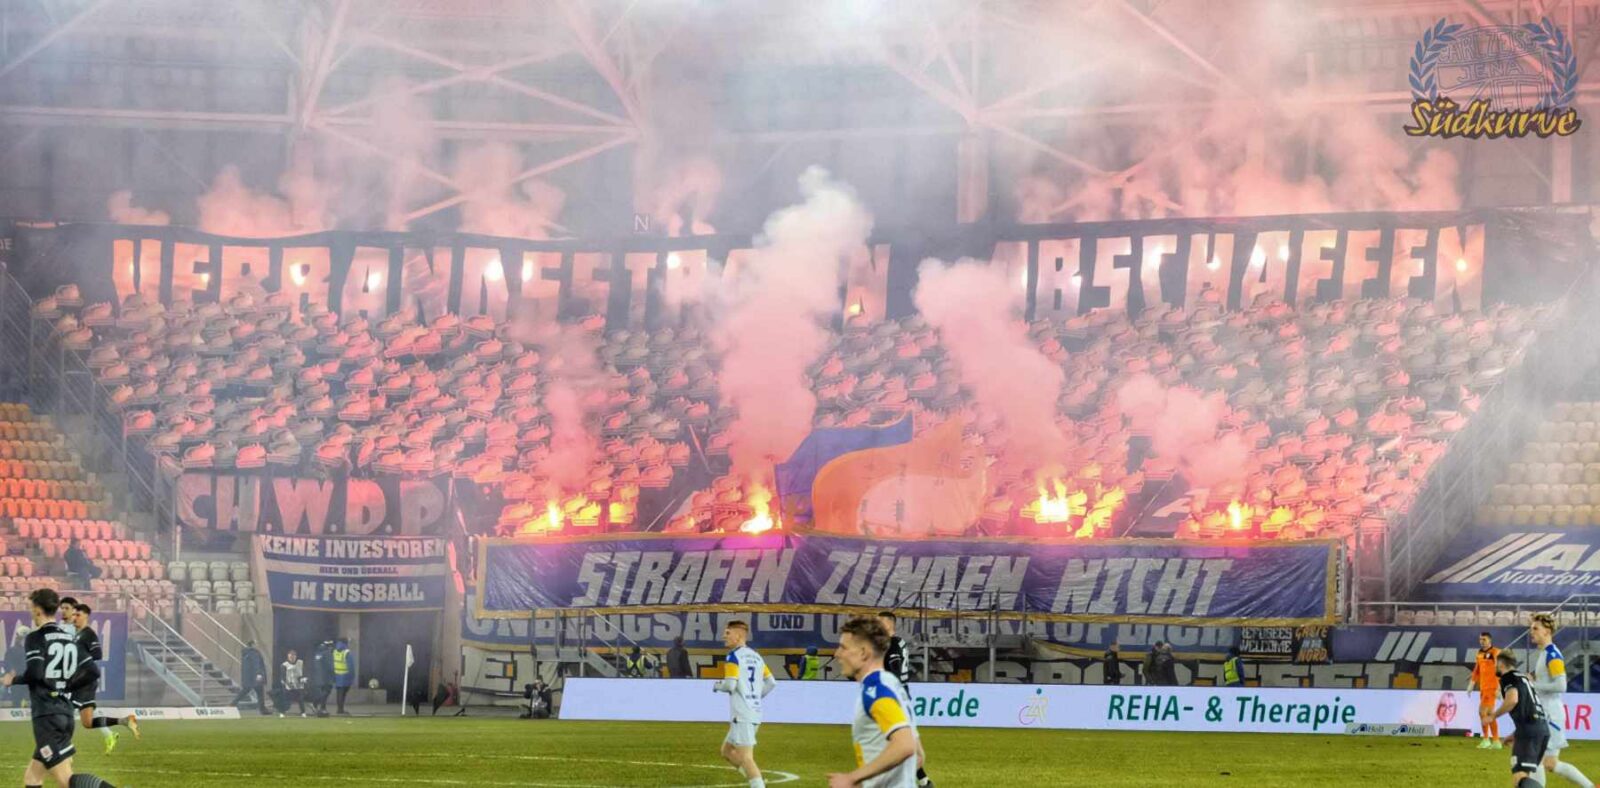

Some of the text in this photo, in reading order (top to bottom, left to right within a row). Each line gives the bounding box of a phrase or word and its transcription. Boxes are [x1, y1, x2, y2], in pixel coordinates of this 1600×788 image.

[259, 534, 445, 559] KEINE INVESTOREN
[292, 581, 424, 602] IM FUSSBALL
[572, 546, 1234, 617] STRAFEN ZÜNDEN NICHT
[769, 615, 804, 629] UND
[45, 642, 78, 679] 20
[1107, 694, 1356, 730] REHA- & Therapie
